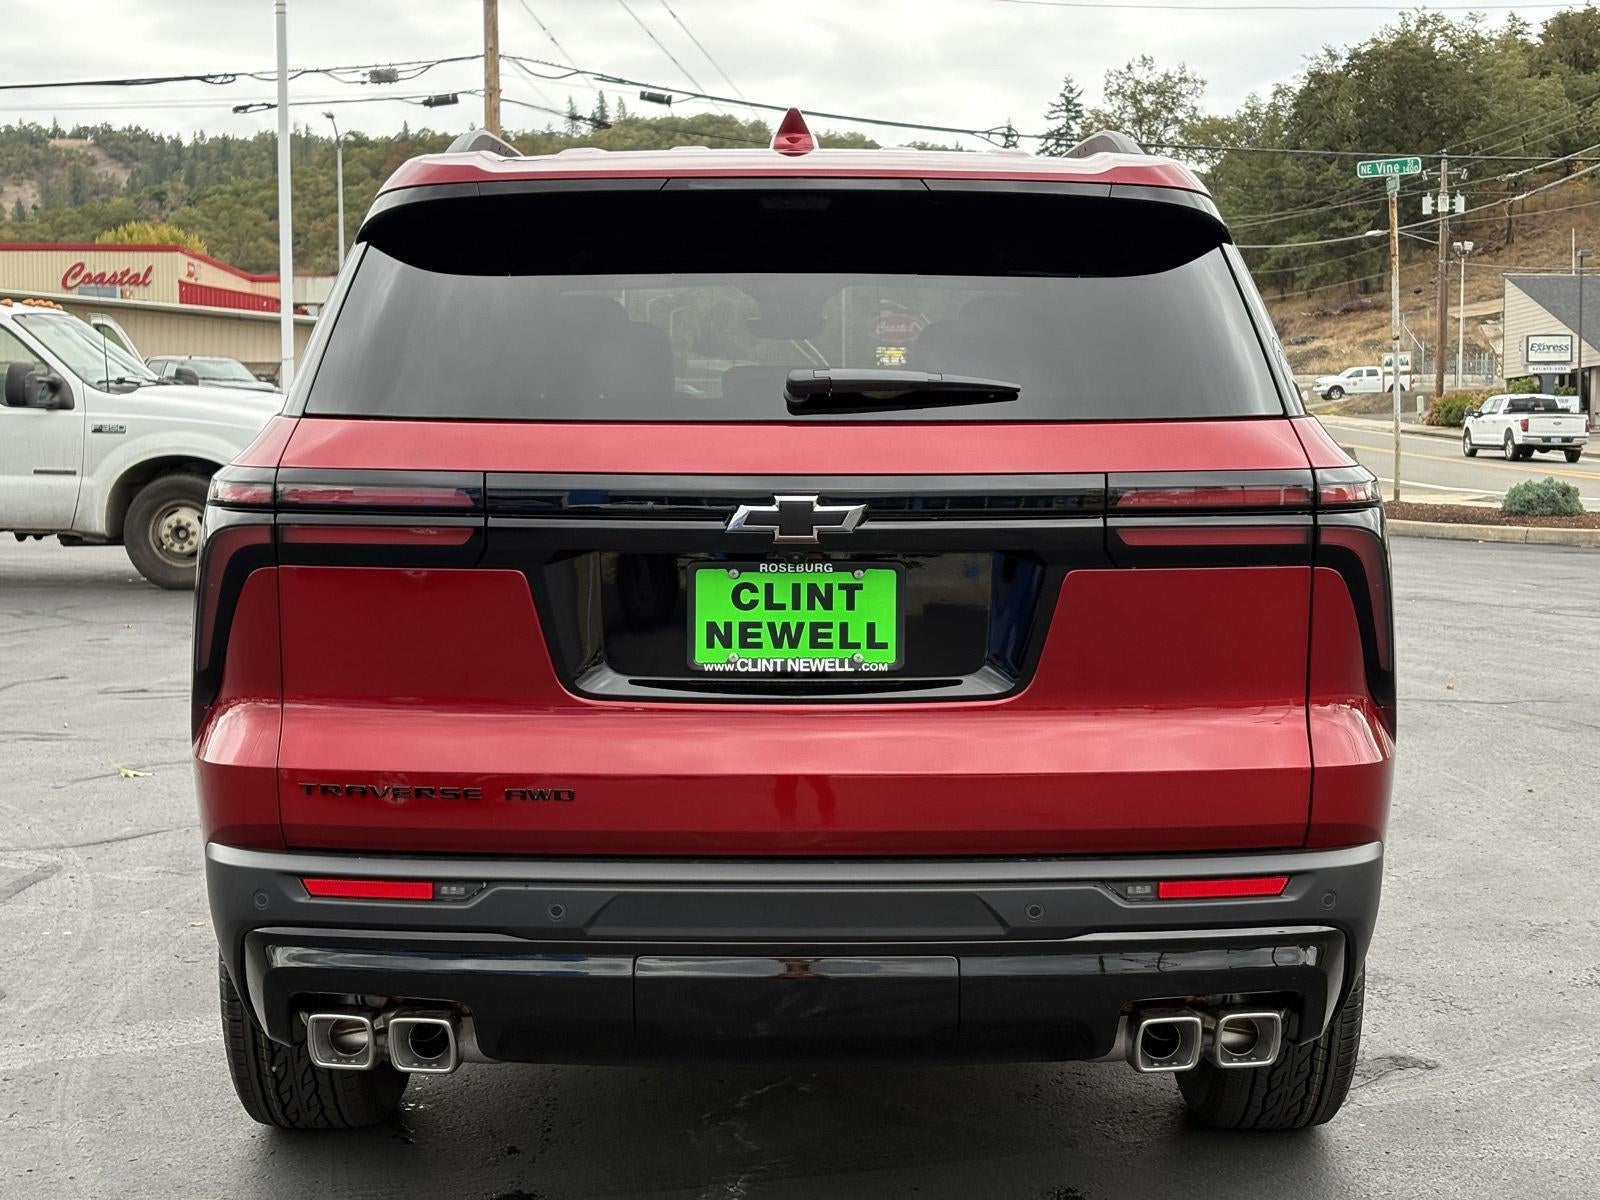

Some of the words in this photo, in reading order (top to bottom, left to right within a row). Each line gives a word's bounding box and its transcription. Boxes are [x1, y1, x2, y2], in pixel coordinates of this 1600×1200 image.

[1360, 165, 1372, 174] NE
[1376, 163, 1400, 174] Vine
[1403, 165, 1419, 174] 1400
[61, 261, 154, 290] Coastal
[1530, 342, 1570, 353] Express
[759, 562, 834, 573] ROSEBURG
[730, 581, 864, 612] CLINT
[705, 621, 889, 650] NEWELL
[298, 782, 482, 800] TRAVERSE
[503, 787, 576, 801] AWD
